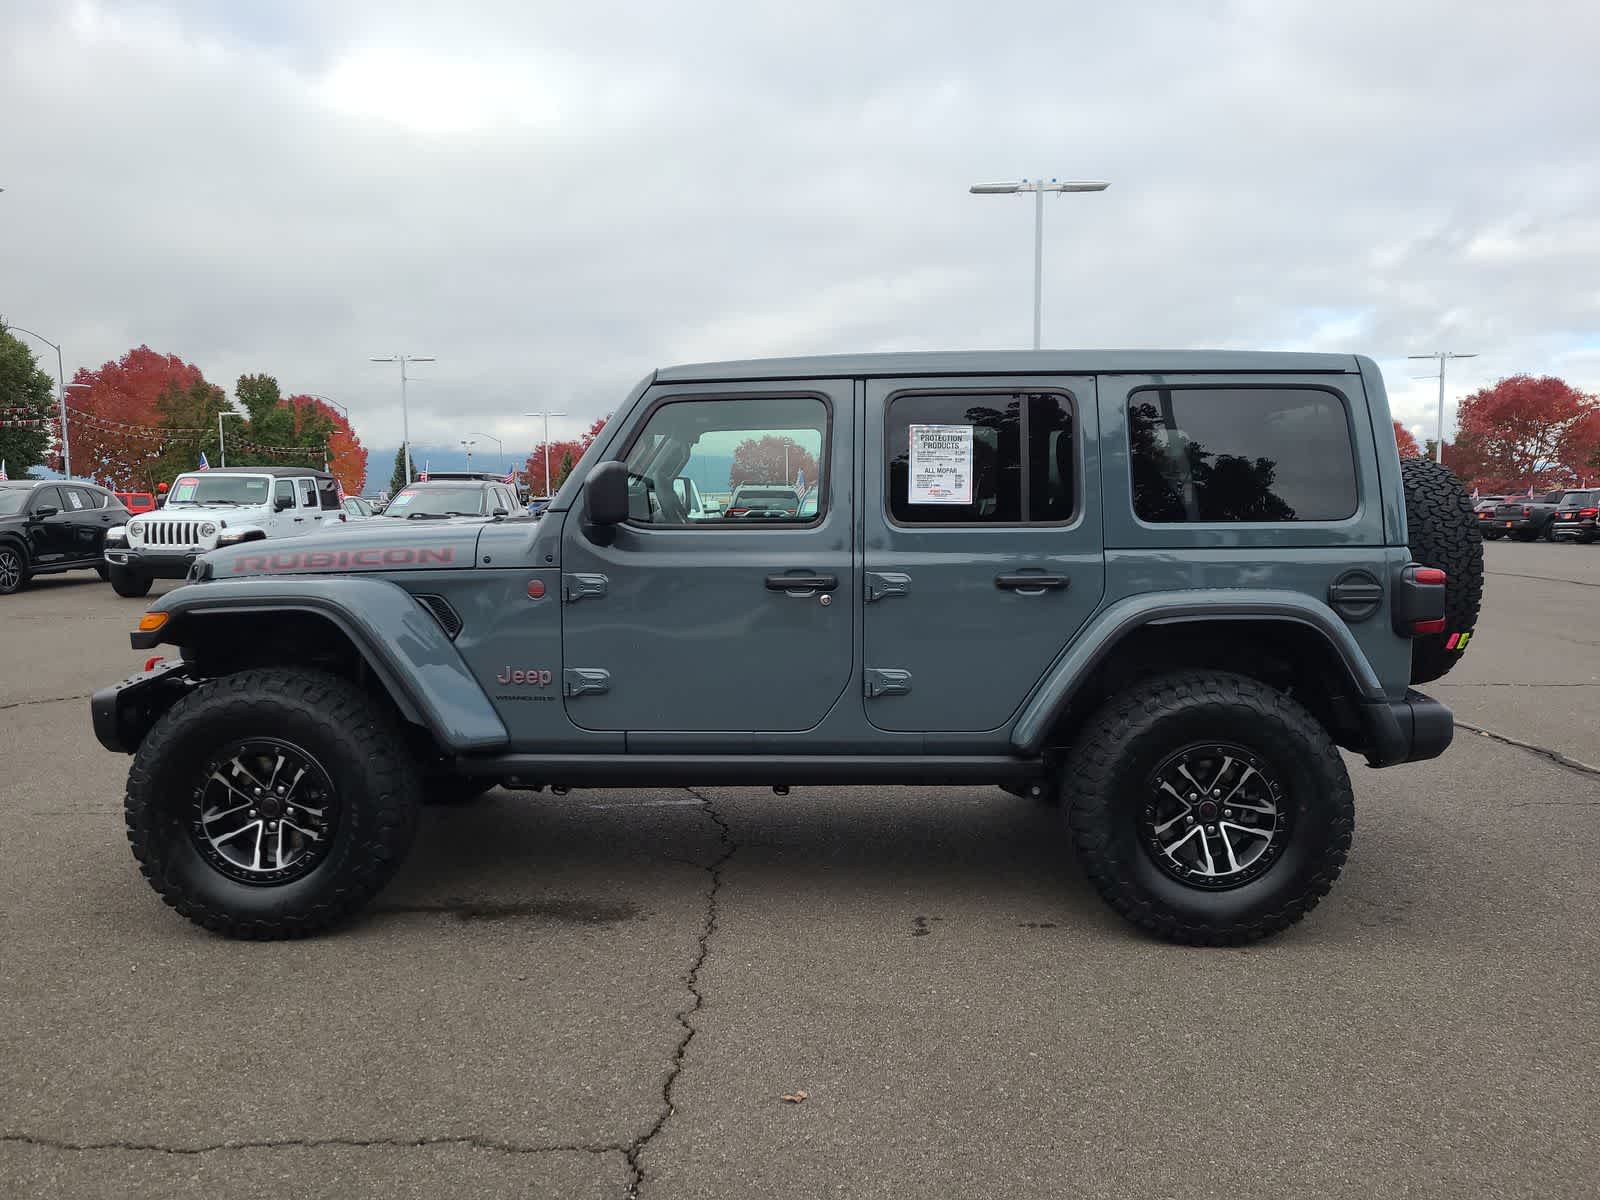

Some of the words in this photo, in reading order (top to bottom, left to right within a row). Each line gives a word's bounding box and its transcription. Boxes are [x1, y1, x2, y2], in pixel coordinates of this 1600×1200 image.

[920, 434, 963, 442] PROTECTION
[232, 547, 456, 573] RUBICON
[496, 665, 552, 688] Jeep
